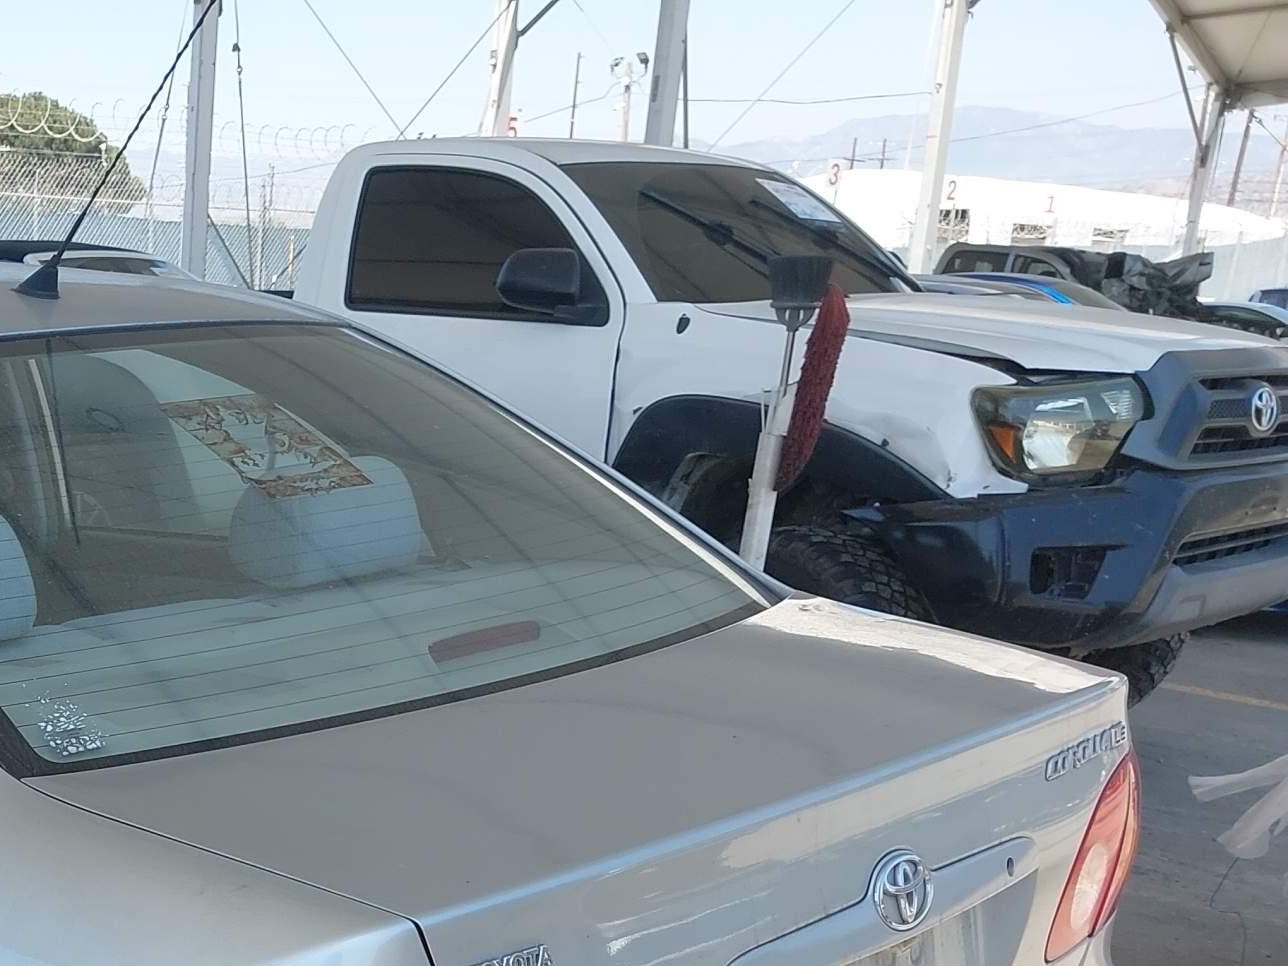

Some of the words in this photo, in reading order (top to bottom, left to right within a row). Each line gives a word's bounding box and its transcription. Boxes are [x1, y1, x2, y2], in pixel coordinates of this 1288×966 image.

[828, 163, 840, 185] 3
[946, 180, 957, 201] 2
[1043, 195, 1055, 213] 1
